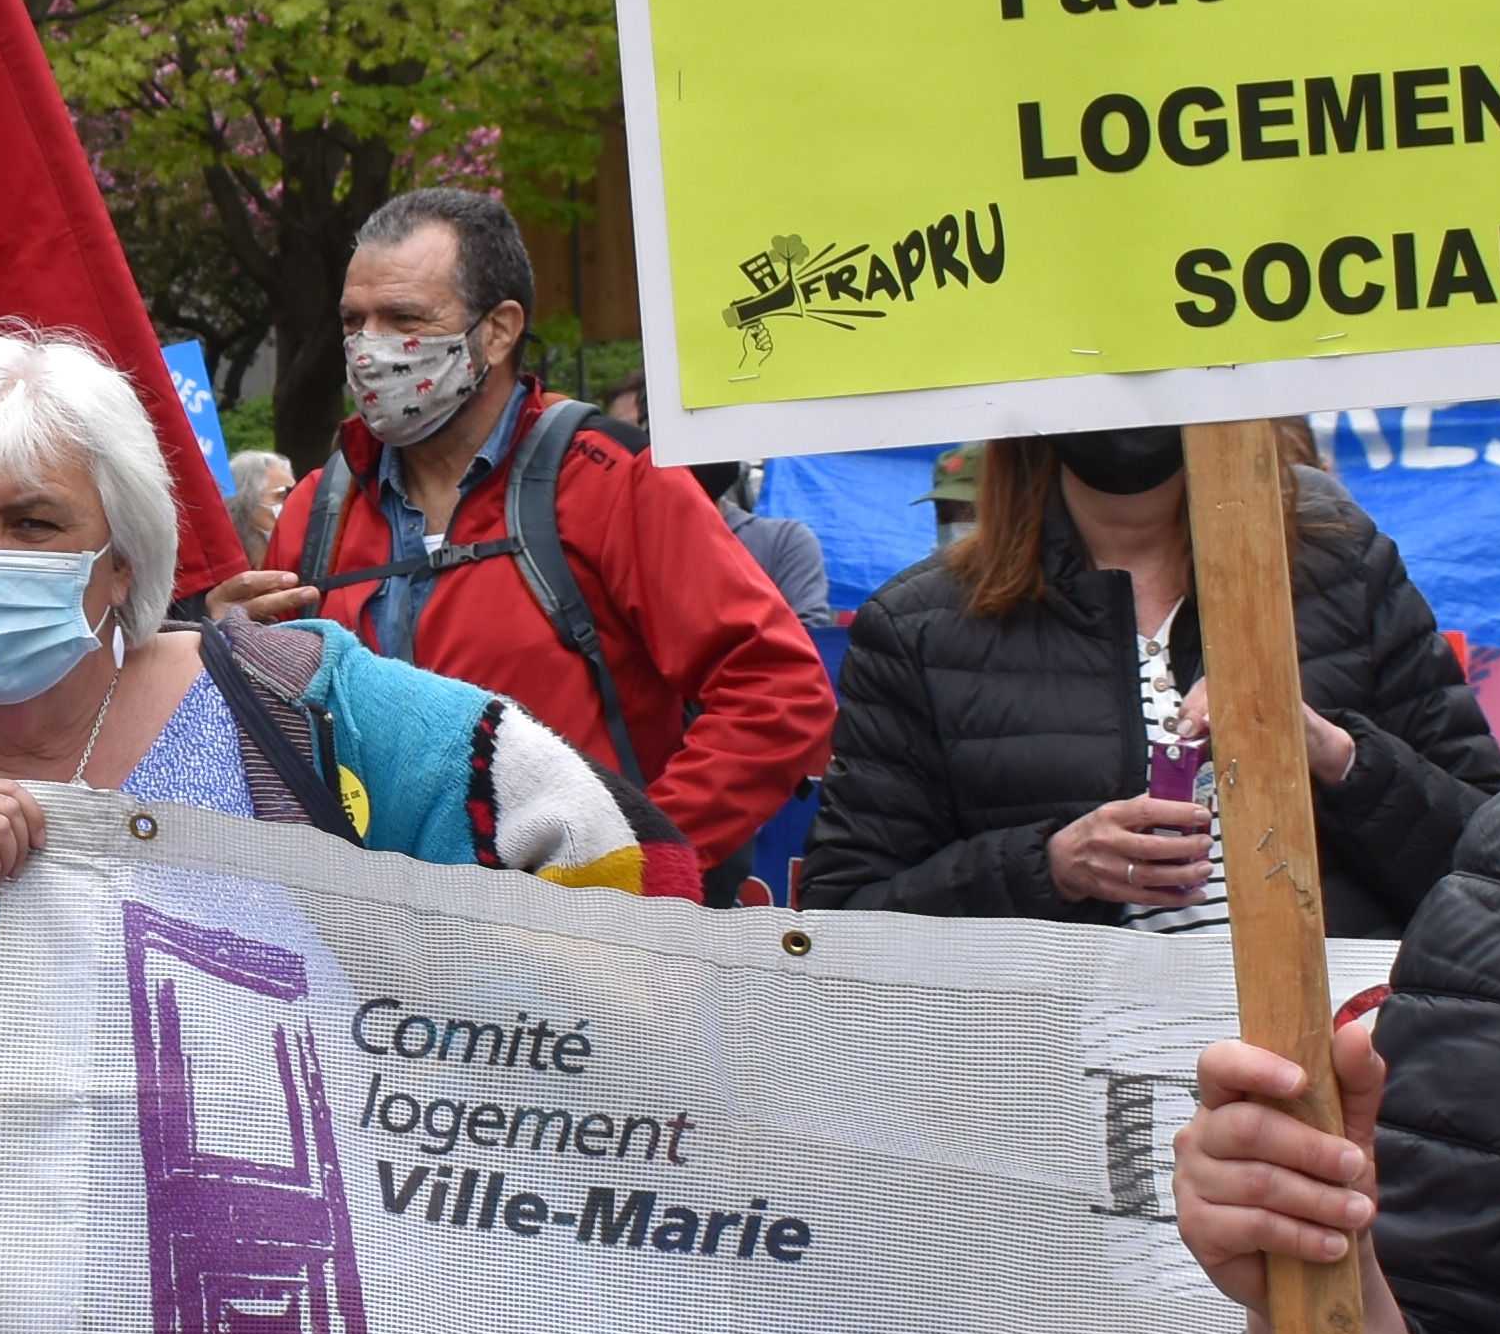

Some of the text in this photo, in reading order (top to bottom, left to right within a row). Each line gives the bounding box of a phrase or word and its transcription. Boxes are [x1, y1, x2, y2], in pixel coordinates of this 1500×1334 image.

[800, 202, 1005, 305] FRAPRU
[351, 996, 592, 1075] Comité
[358, 1071, 695, 1169] logement
[374, 1160, 814, 1265] Ville-Marie
